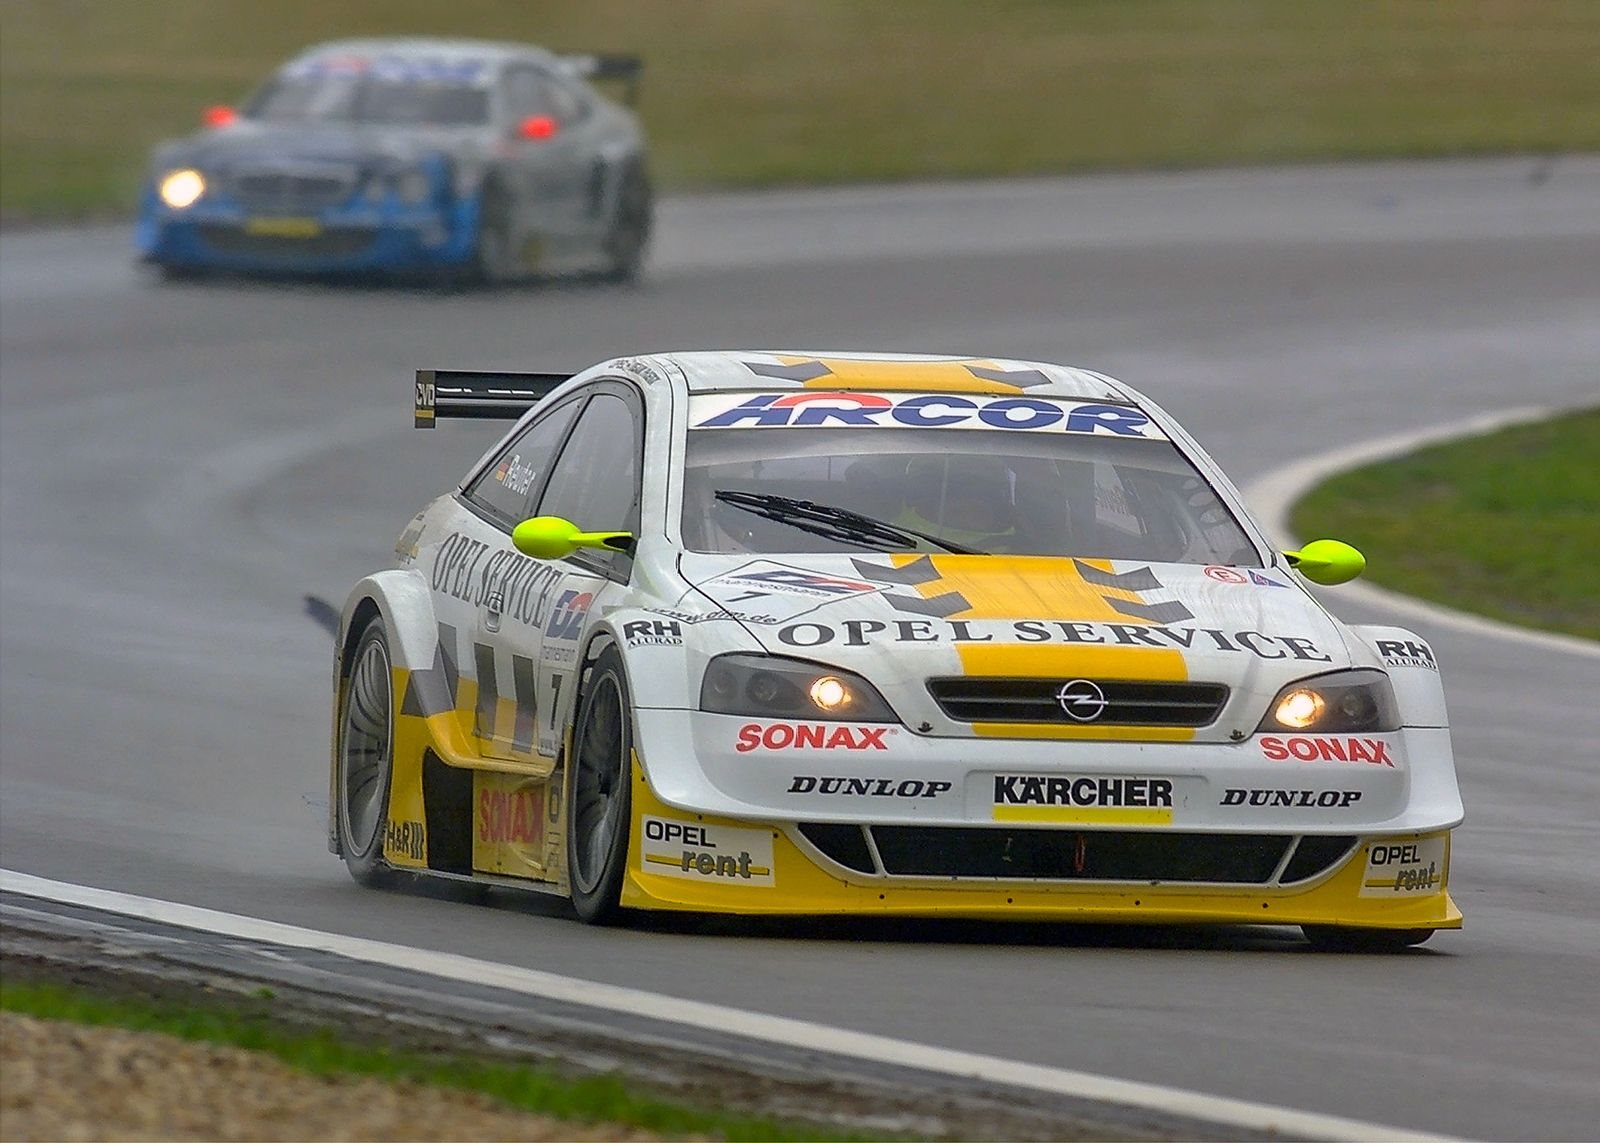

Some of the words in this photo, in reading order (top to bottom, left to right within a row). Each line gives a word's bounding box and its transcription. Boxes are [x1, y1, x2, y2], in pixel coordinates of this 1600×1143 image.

[695, 392, 1150, 436] ARCOR
[432, 532, 490, 603] OPEL
[474, 548, 563, 629] SERVICE
[545, 589, 593, 641] D2
[623, 620, 682, 640] RH
[629, 636, 684, 650] ALURAD
[777, 619, 993, 647] OPEL
[1014, 620, 1332, 663] SERVICE
[1375, 640, 1434, 663] RH
[736, 723, 888, 752] SONAX
[1259, 737, 1395, 768] SONAX
[787, 776, 953, 799] DUNLOP
[994, 774, 1173, 808] KÄRCHER
[1220, 788, 1362, 808] DUNLOP
[386, 821, 409, 854] H&R
[645, 820, 717, 849] OPEL
[681, 850, 753, 880] rent
[1370, 845, 1421, 866] OPEL
[1394, 862, 1436, 891] rent
